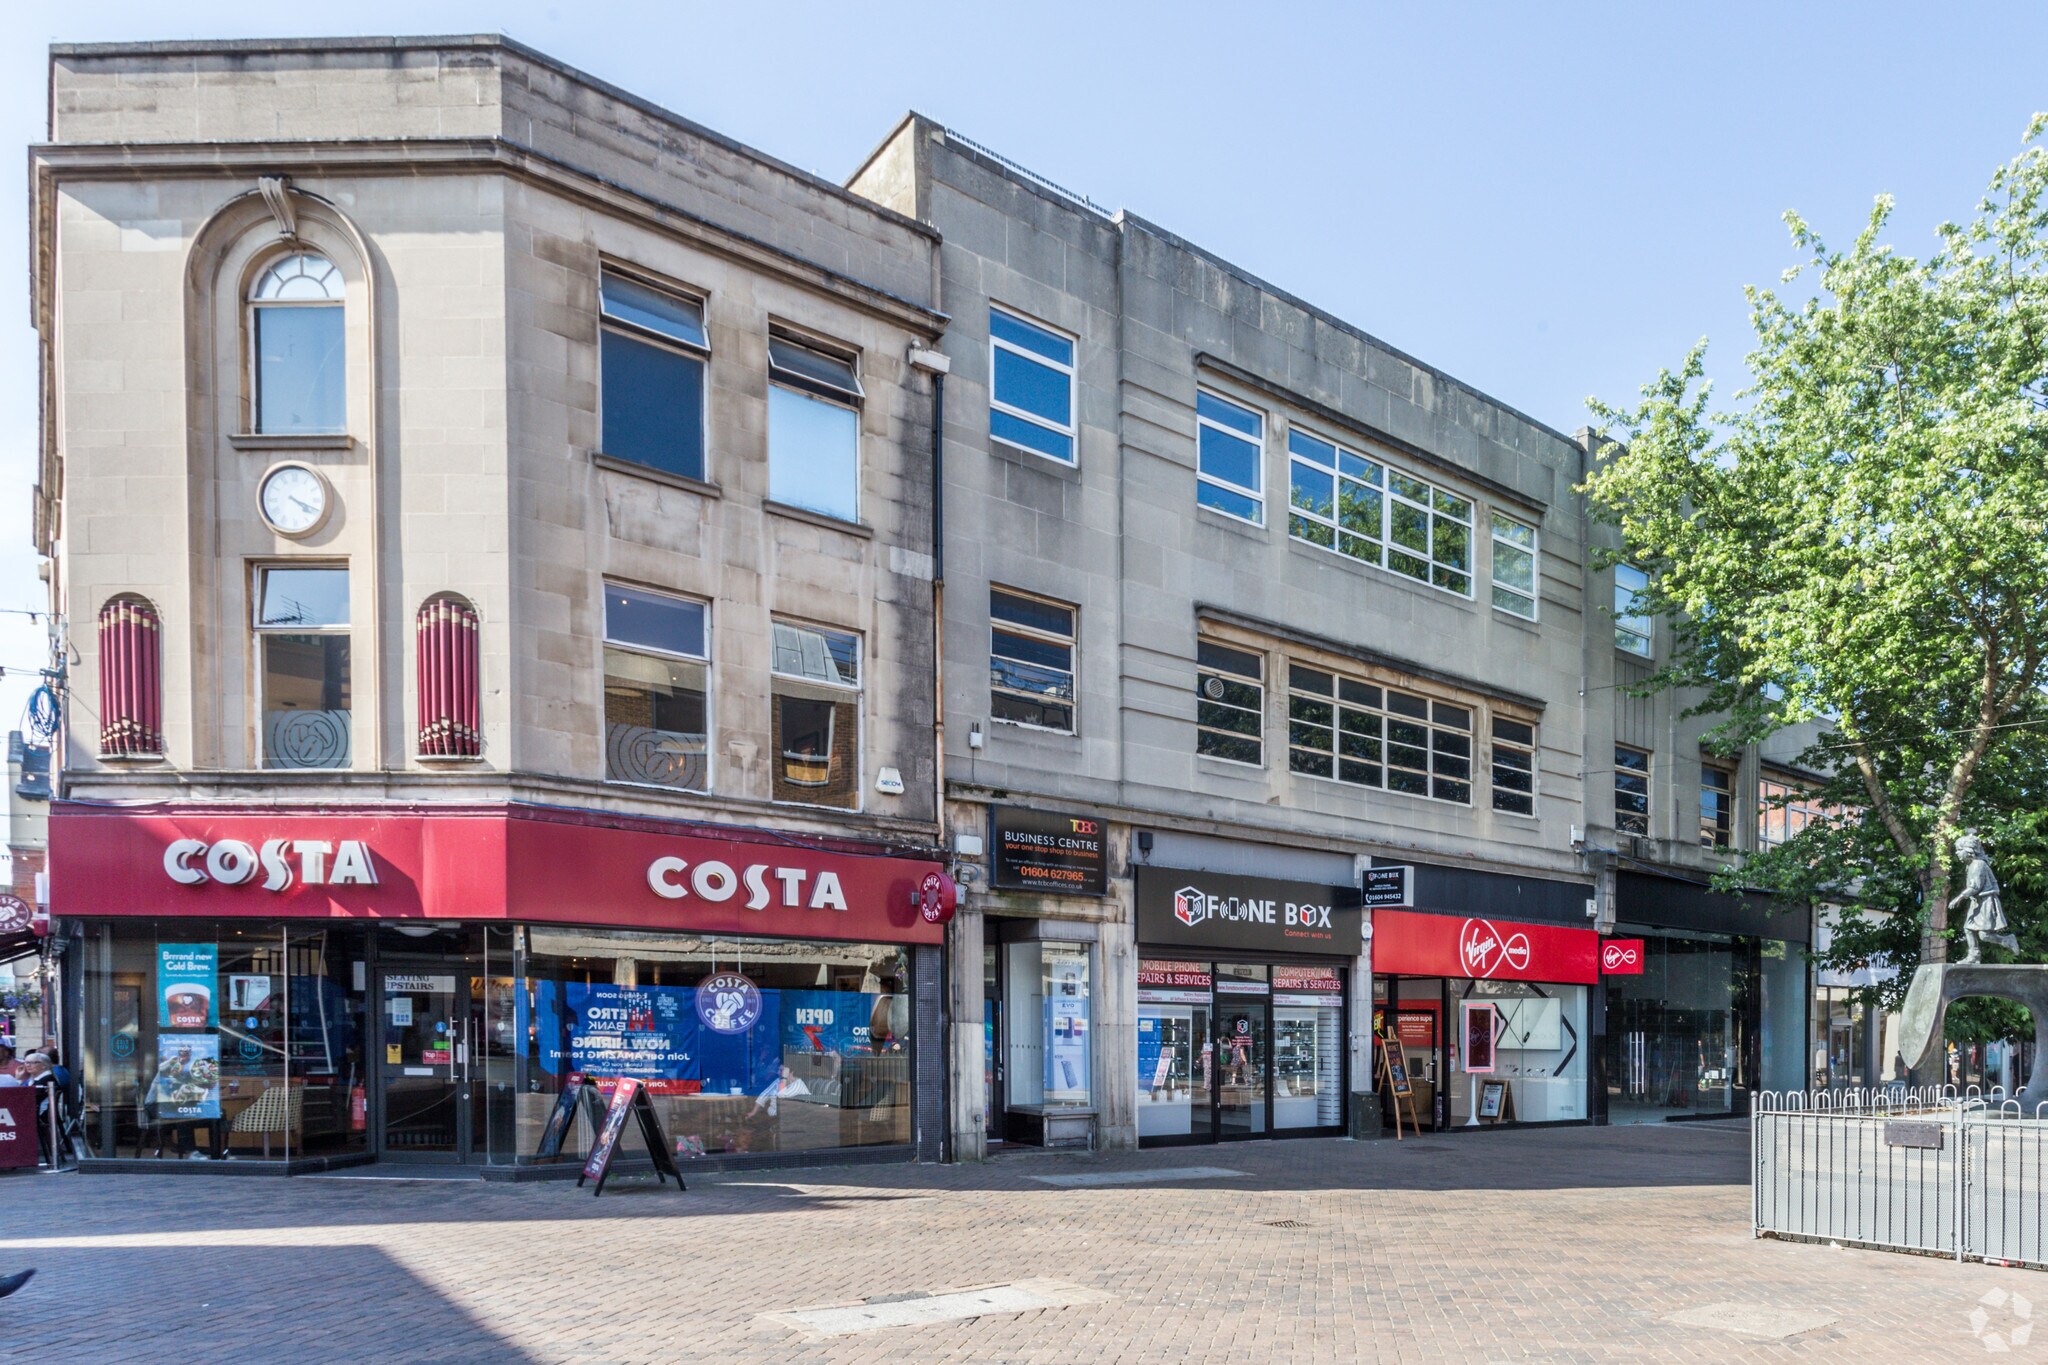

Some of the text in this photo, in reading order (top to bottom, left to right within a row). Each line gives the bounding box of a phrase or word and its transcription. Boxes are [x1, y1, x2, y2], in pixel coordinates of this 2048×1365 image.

[1004, 830, 1099, 851] BUSINESS CENTRE
[1005, 842, 1020, 851] your
[1021, 844, 1034, 852] one
[1034, 846, 1049, 854] stop
[1049, 847, 1064, 856] shop
[1073, 850, 1099, 859] business
[163, 838, 379, 892] COSTA
[1020, 865, 1049, 879] 01604
[1050, 868, 1084, 882] 627965
[646, 855, 849, 911] COSTA
[923, 876, 940, 891] COSTA
[1022, 879, 1084, 890] www.tcbcoffices.co.uk
[922, 902, 942, 919] COFFEE
[1284, 928, 1310, 938] Connect
[1310, 931, 1324, 939] with
[1465, 927, 1527, 969] Virgin media
[1605, 949, 1621, 965] Virgin
[165, 961, 211, 971] Cold Brew.
[1142, 960, 1200, 973] MOBILE PHONE
[1320, 968, 1335, 979] MAC
[707, 976, 750, 996] COSTA
[1138, 972, 1212, 985] EPAIRS & SERVICES
[1272, 979, 1341, 990] REPAIRS & SERVICES
[176, 1016, 201, 1024] COSTA
[704, 1007, 756, 1030] COFFEE
[177, 1106, 202, 1114] COSTA
